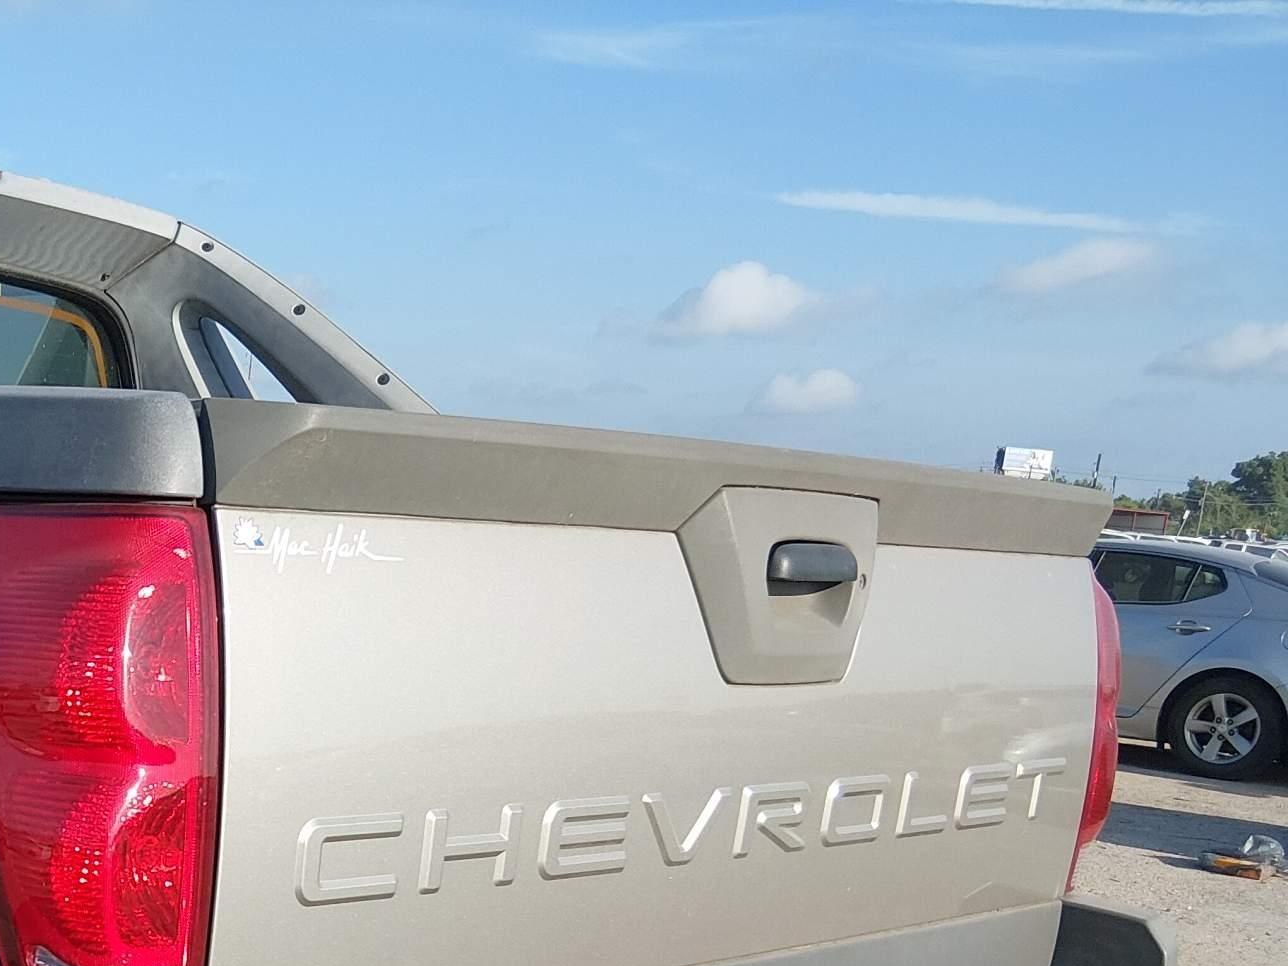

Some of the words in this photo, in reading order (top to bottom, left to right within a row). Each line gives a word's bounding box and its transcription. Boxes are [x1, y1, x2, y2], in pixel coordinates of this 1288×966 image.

[262, 524, 319, 575] Mac
[320, 523, 400, 575] Haik
[295, 757, 1068, 907] CHEVROLET
